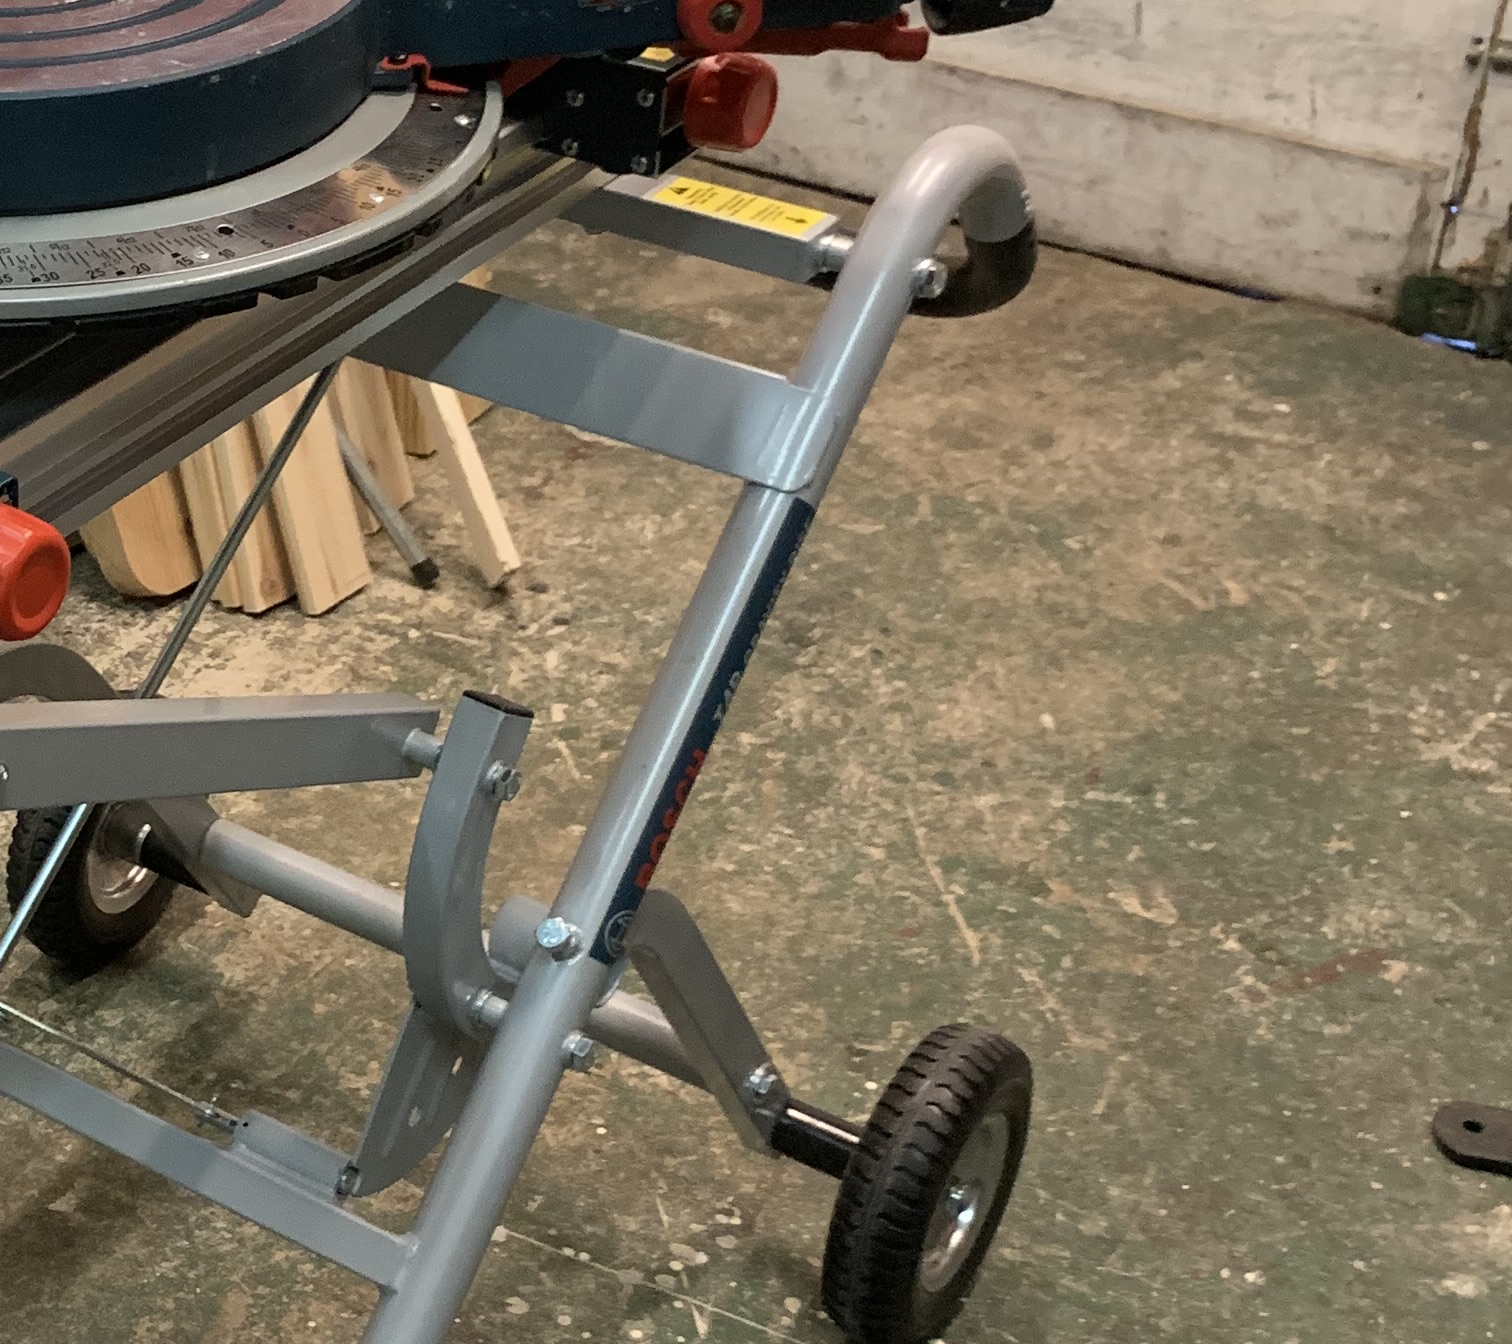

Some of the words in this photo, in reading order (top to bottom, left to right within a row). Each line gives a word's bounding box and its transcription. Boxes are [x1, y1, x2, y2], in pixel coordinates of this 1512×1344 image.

[40, 271, 60, 283] 30
[87, 267, 106, 280] 25
[131, 262, 152, 274] 20
[176, 256, 194, 268] 15
[218, 248, 236, 259] 10
